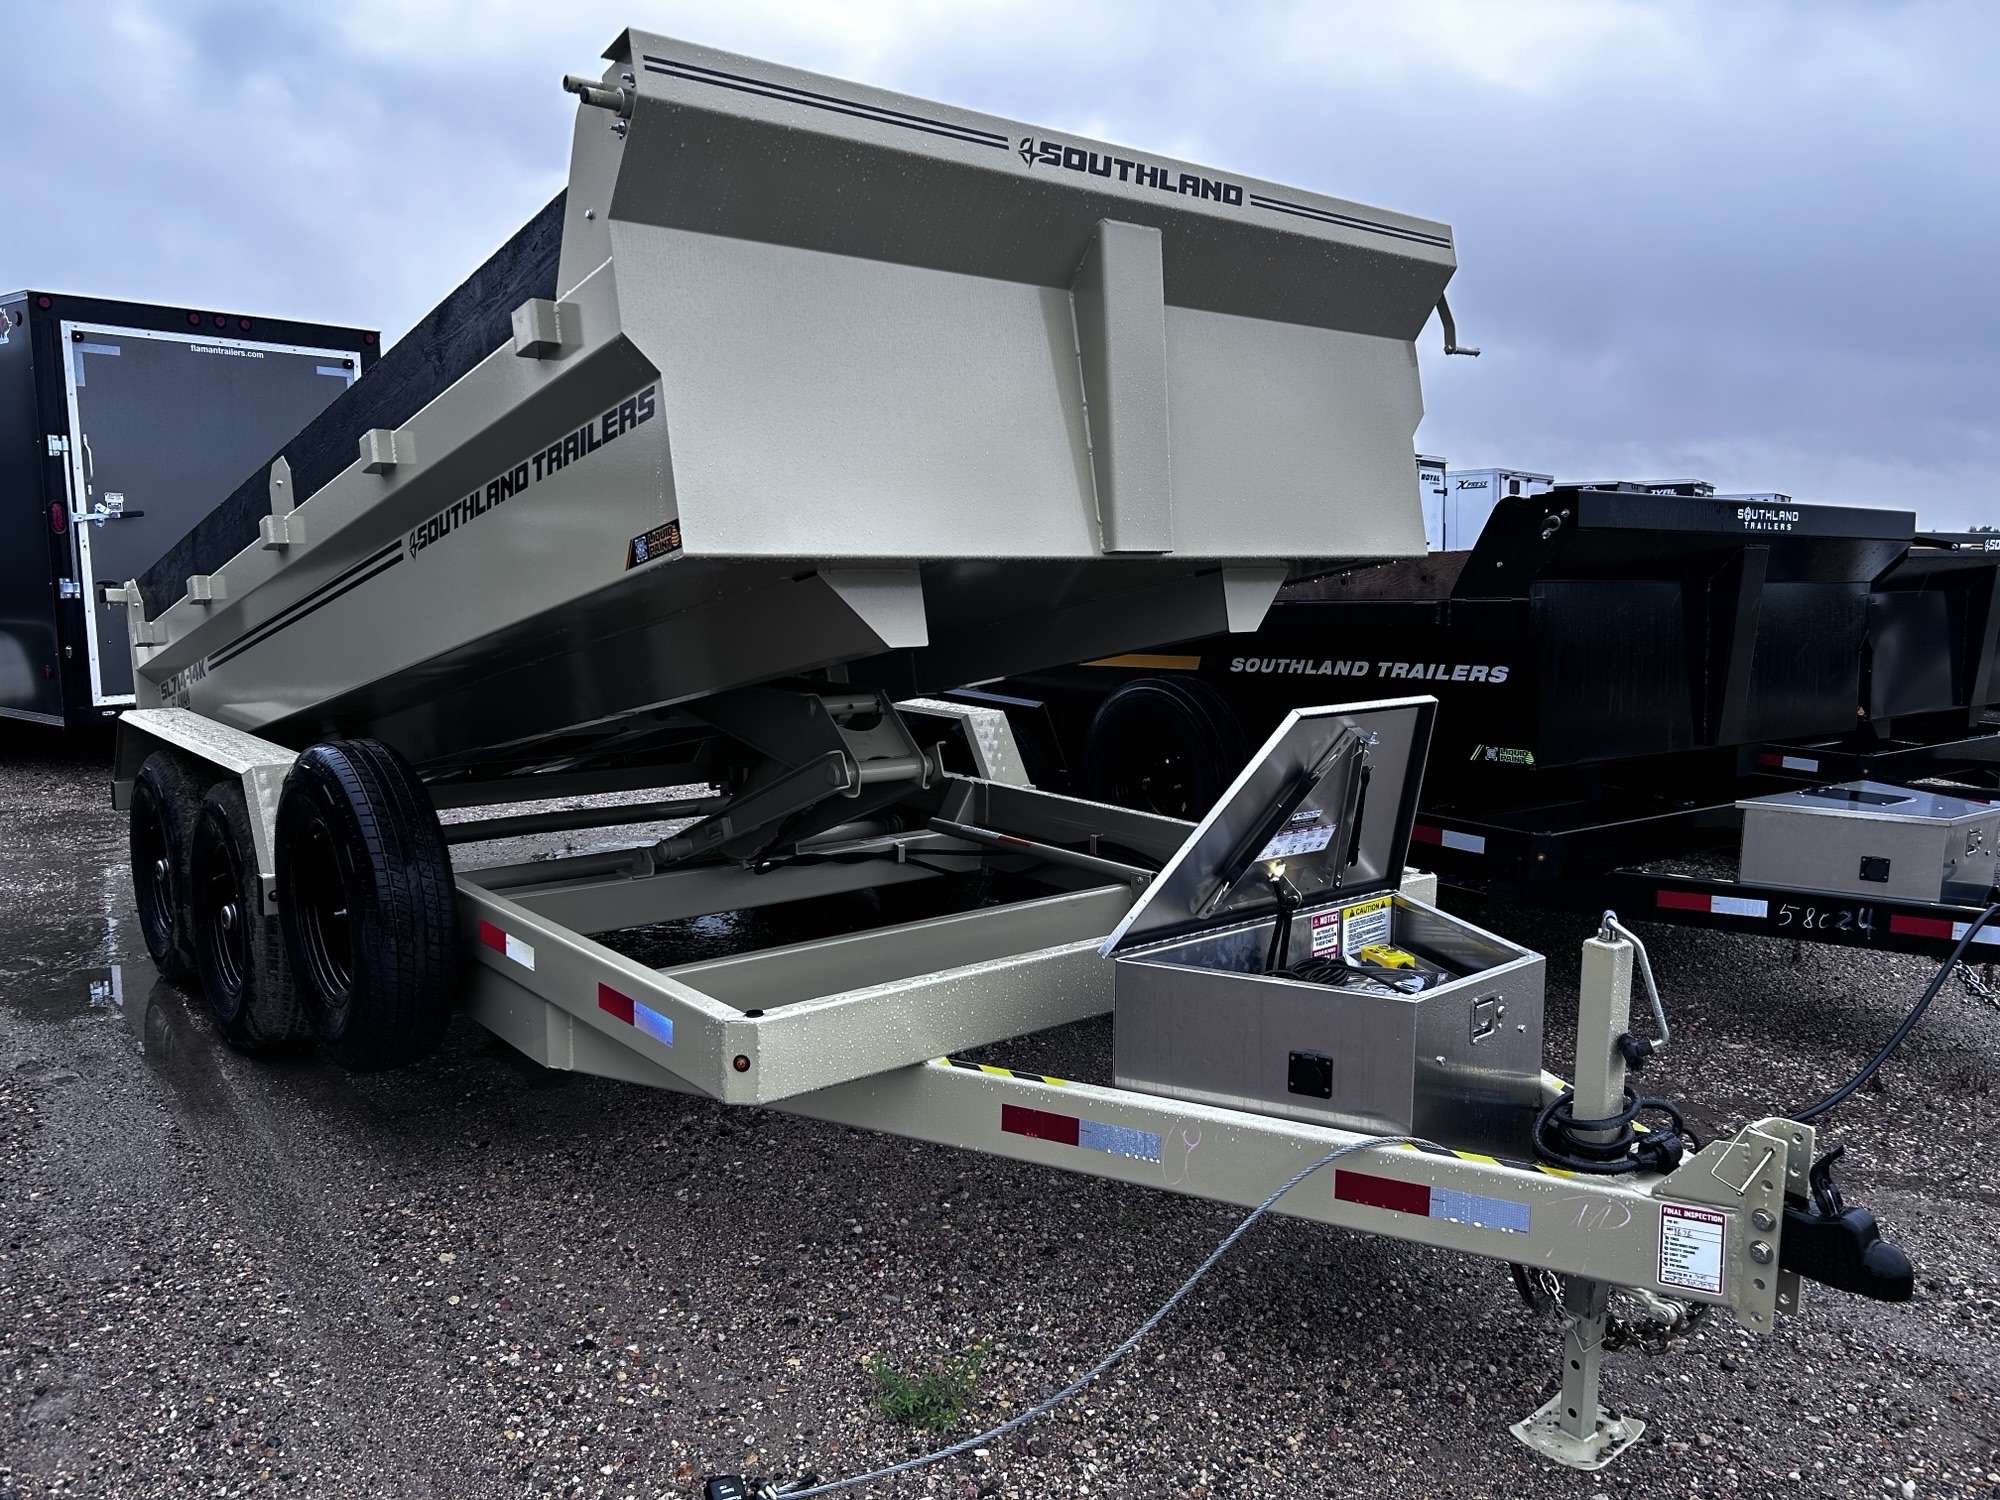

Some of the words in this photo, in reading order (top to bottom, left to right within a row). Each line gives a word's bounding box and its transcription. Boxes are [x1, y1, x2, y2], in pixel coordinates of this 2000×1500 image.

[1038, 141, 1243, 206] SOUTHLAND
[190, 344, 264, 359] flamantrailers.com
[417, 461, 529, 551] SOUTHLAND
[532, 385, 655, 482] TRAILERS
[1420, 473, 1441, 482] ROYAL
[1737, 506, 1799, 522] SOUTHLAND
[1744, 521, 1792, 531] TRAILERS
[1230, 657, 1370, 677] SOUTHLAND
[1378, 662, 1510, 683] TRAILERS
[1356, 902, 1380, 915] CAUTION
[1663, 1207, 1683, 1217] FINAL
[1683, 1210, 1723, 1223] INSPECTION
